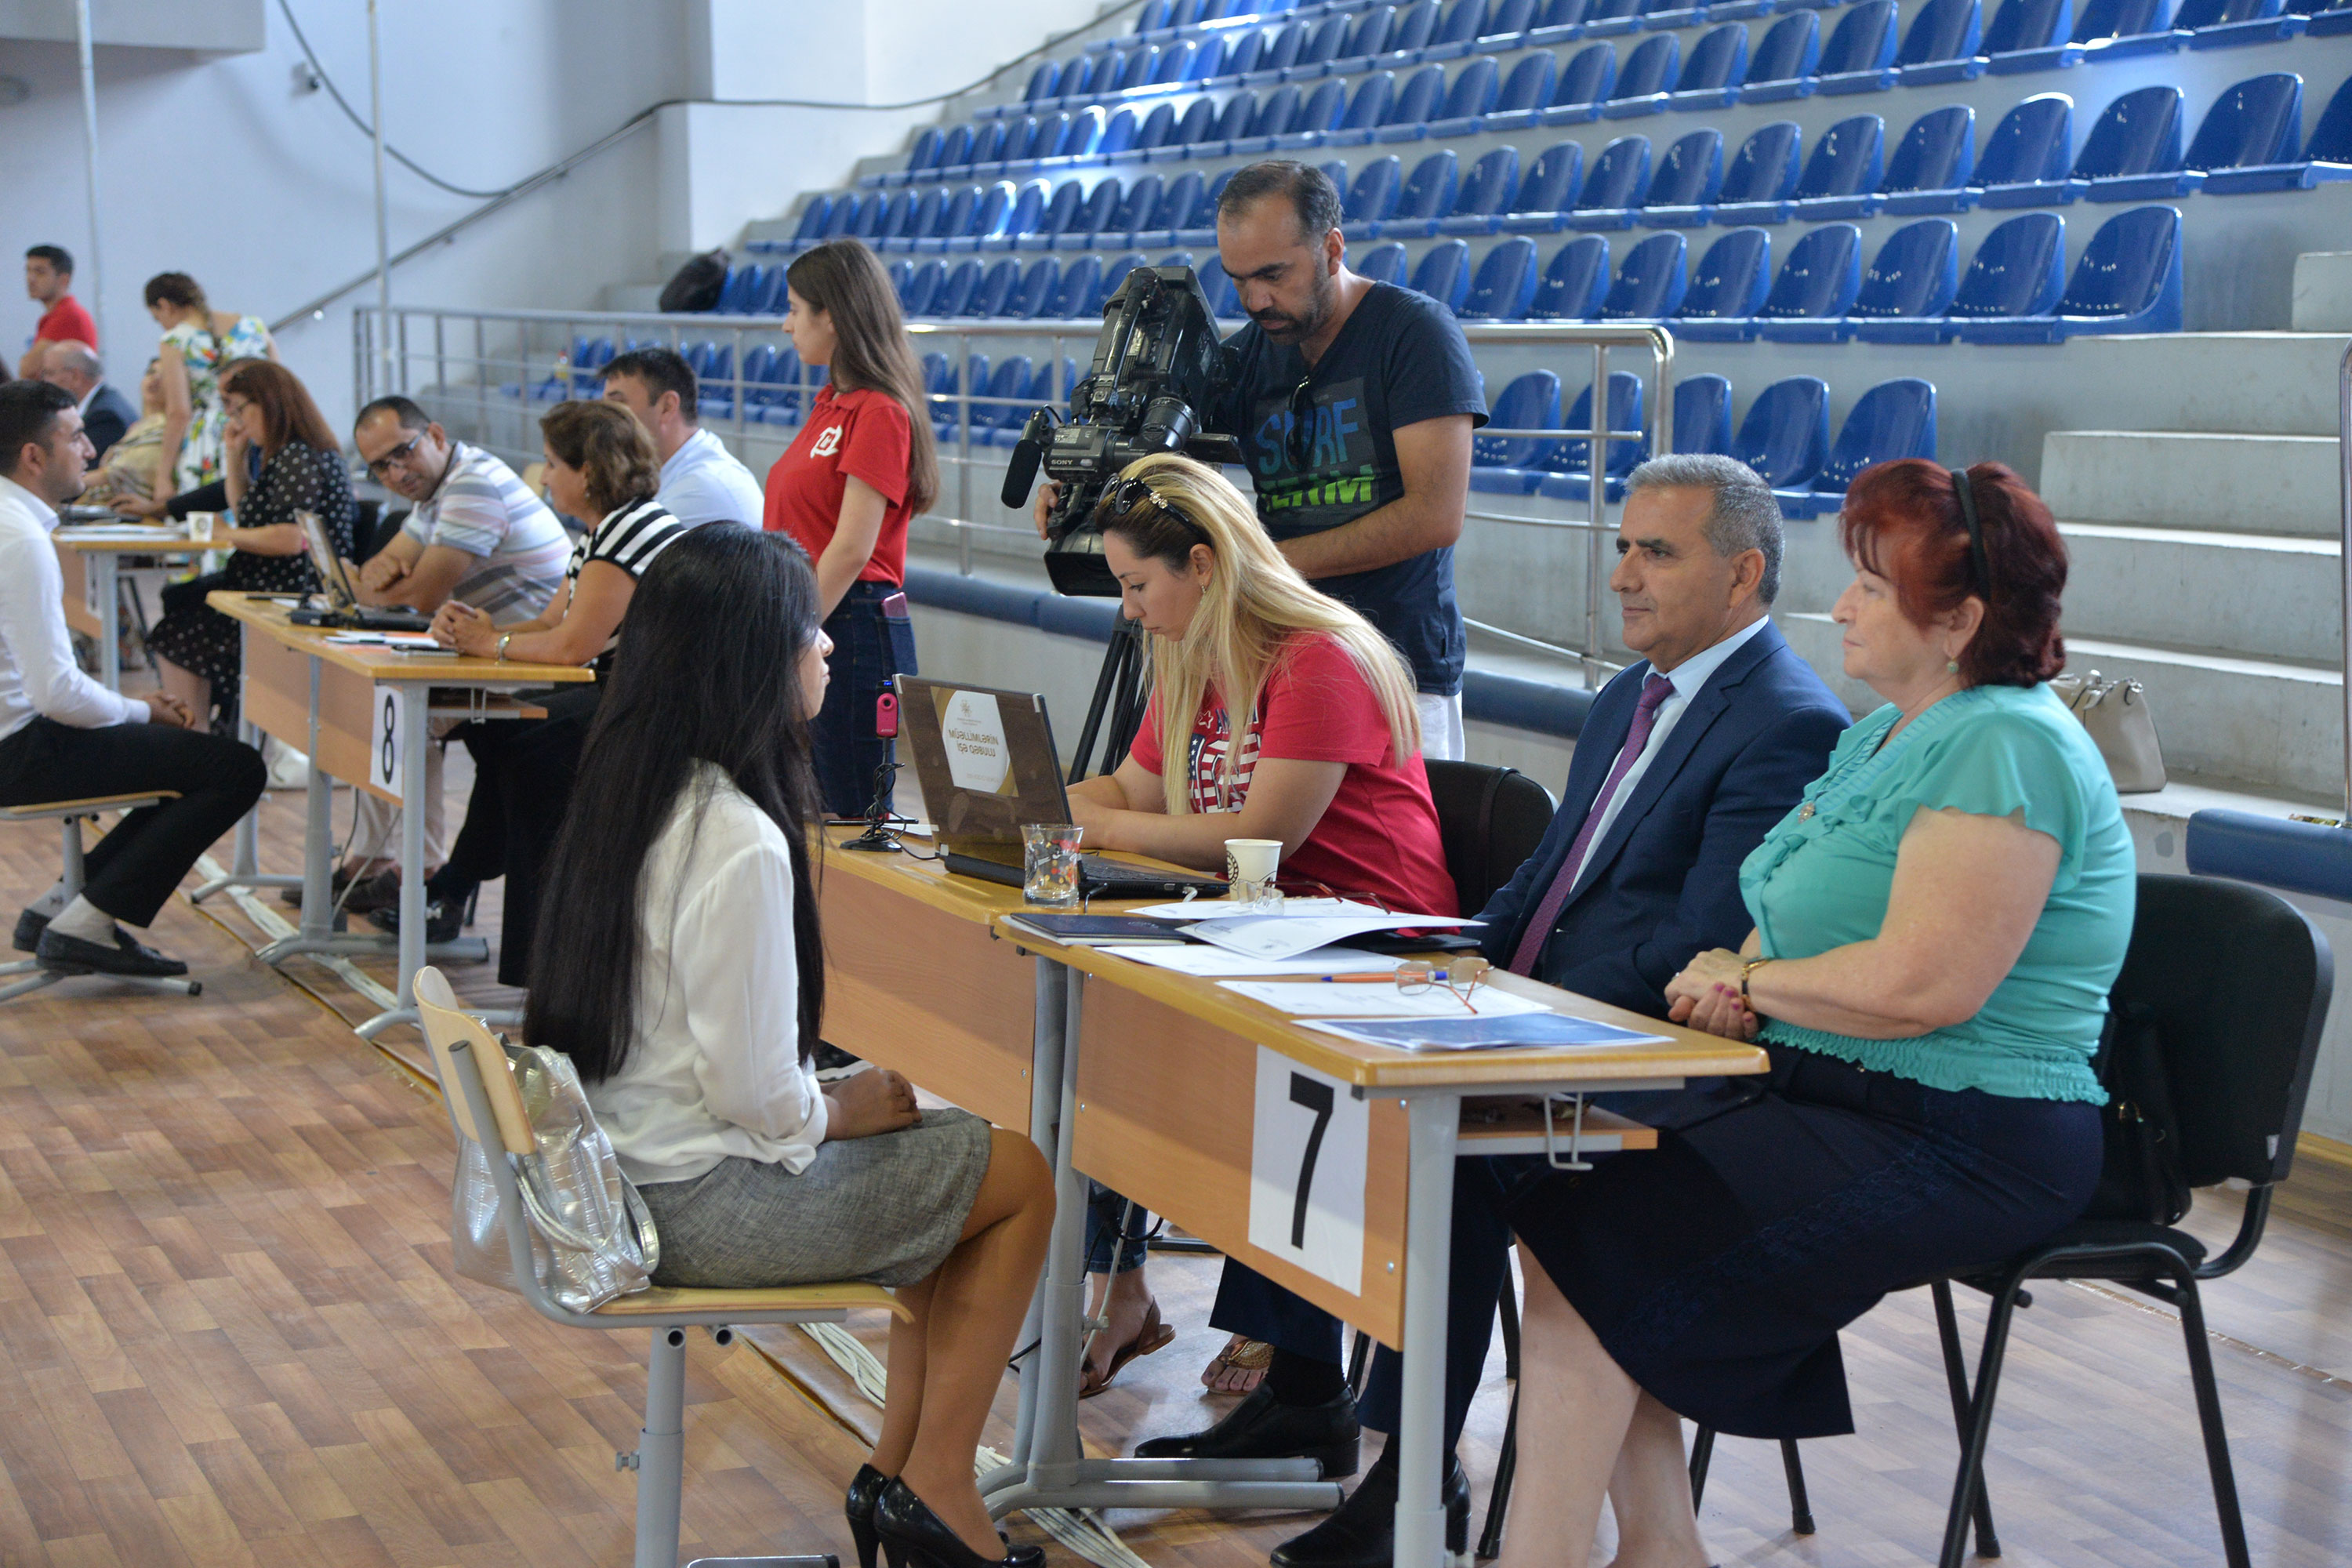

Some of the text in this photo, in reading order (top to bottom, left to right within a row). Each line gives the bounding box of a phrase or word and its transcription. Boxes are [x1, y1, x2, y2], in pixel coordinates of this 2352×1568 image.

[1255, 397, 1359, 475] SURF
[383, 694, 394, 785] 8
[1290, 1070, 1334, 1250] 7
